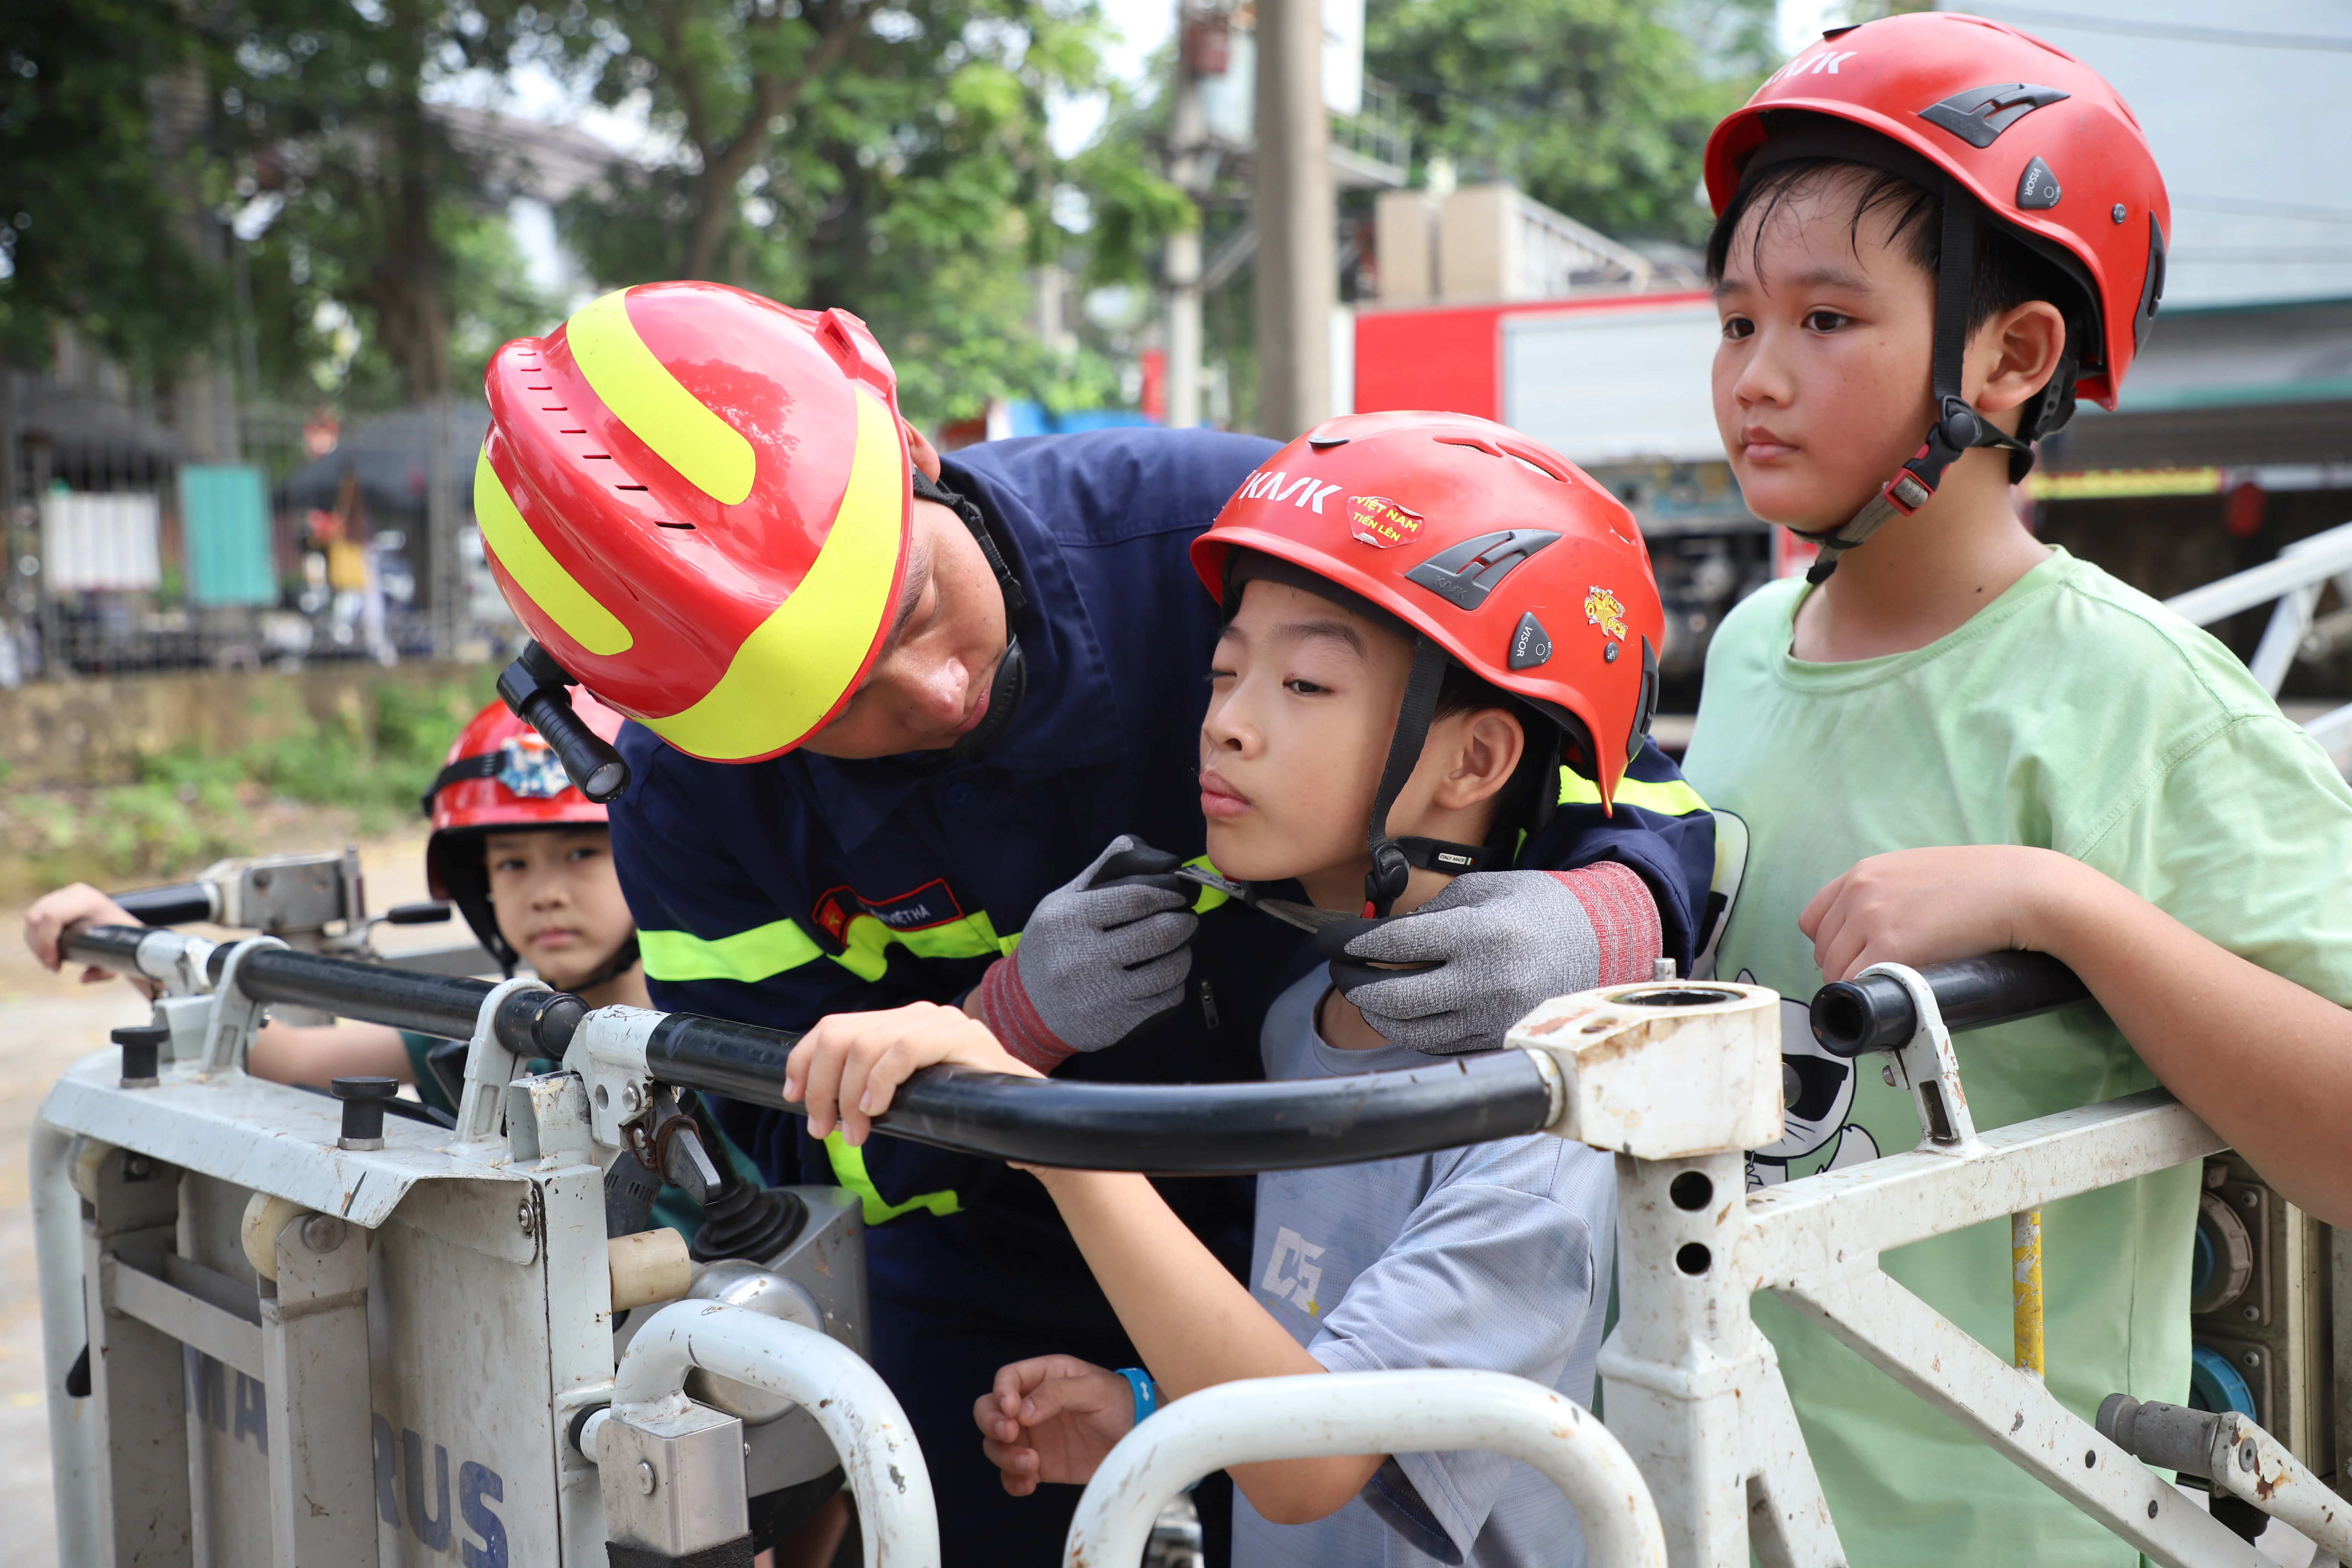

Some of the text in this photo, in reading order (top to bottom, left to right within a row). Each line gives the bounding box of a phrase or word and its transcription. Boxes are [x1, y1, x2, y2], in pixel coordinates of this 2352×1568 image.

[1763, 51, 1858, 88] ASK
[2024, 168, 2042, 196] VISOR
[1238, 471, 1343, 514] KASK
[1352, 512, 1401, 542] TIẾN LÊN
[1357, 497, 1419, 533] VIỆT NAM
[1516, 626, 1533, 657] VISOR
